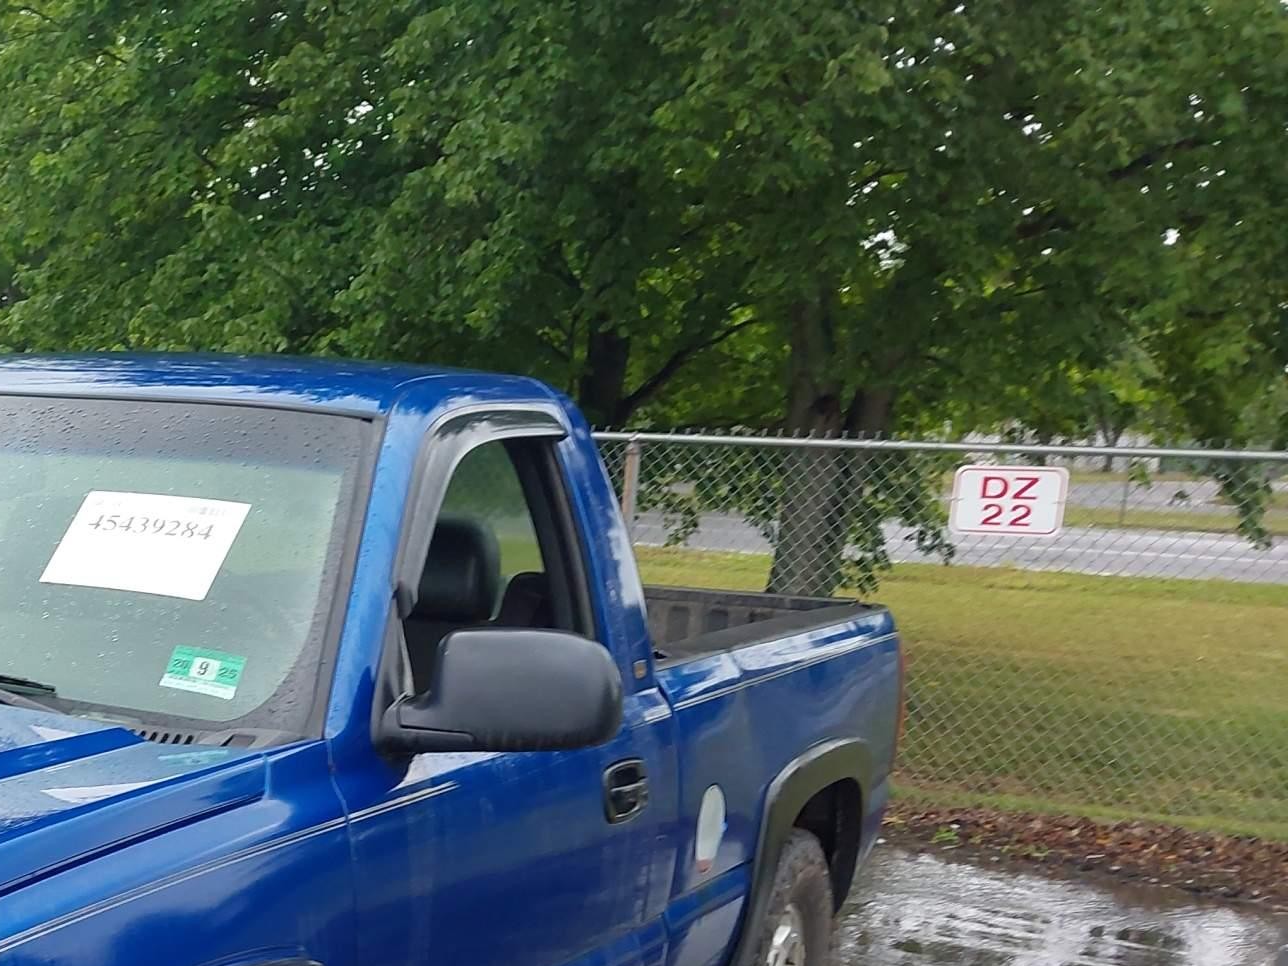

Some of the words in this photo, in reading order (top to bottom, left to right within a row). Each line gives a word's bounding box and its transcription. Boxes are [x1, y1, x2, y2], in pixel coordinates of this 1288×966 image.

[981, 476, 1040, 500] DZ
[88, 514, 215, 540] 45439284
[980, 503, 1031, 527] 22
[196, 660, 209, 676] 9
